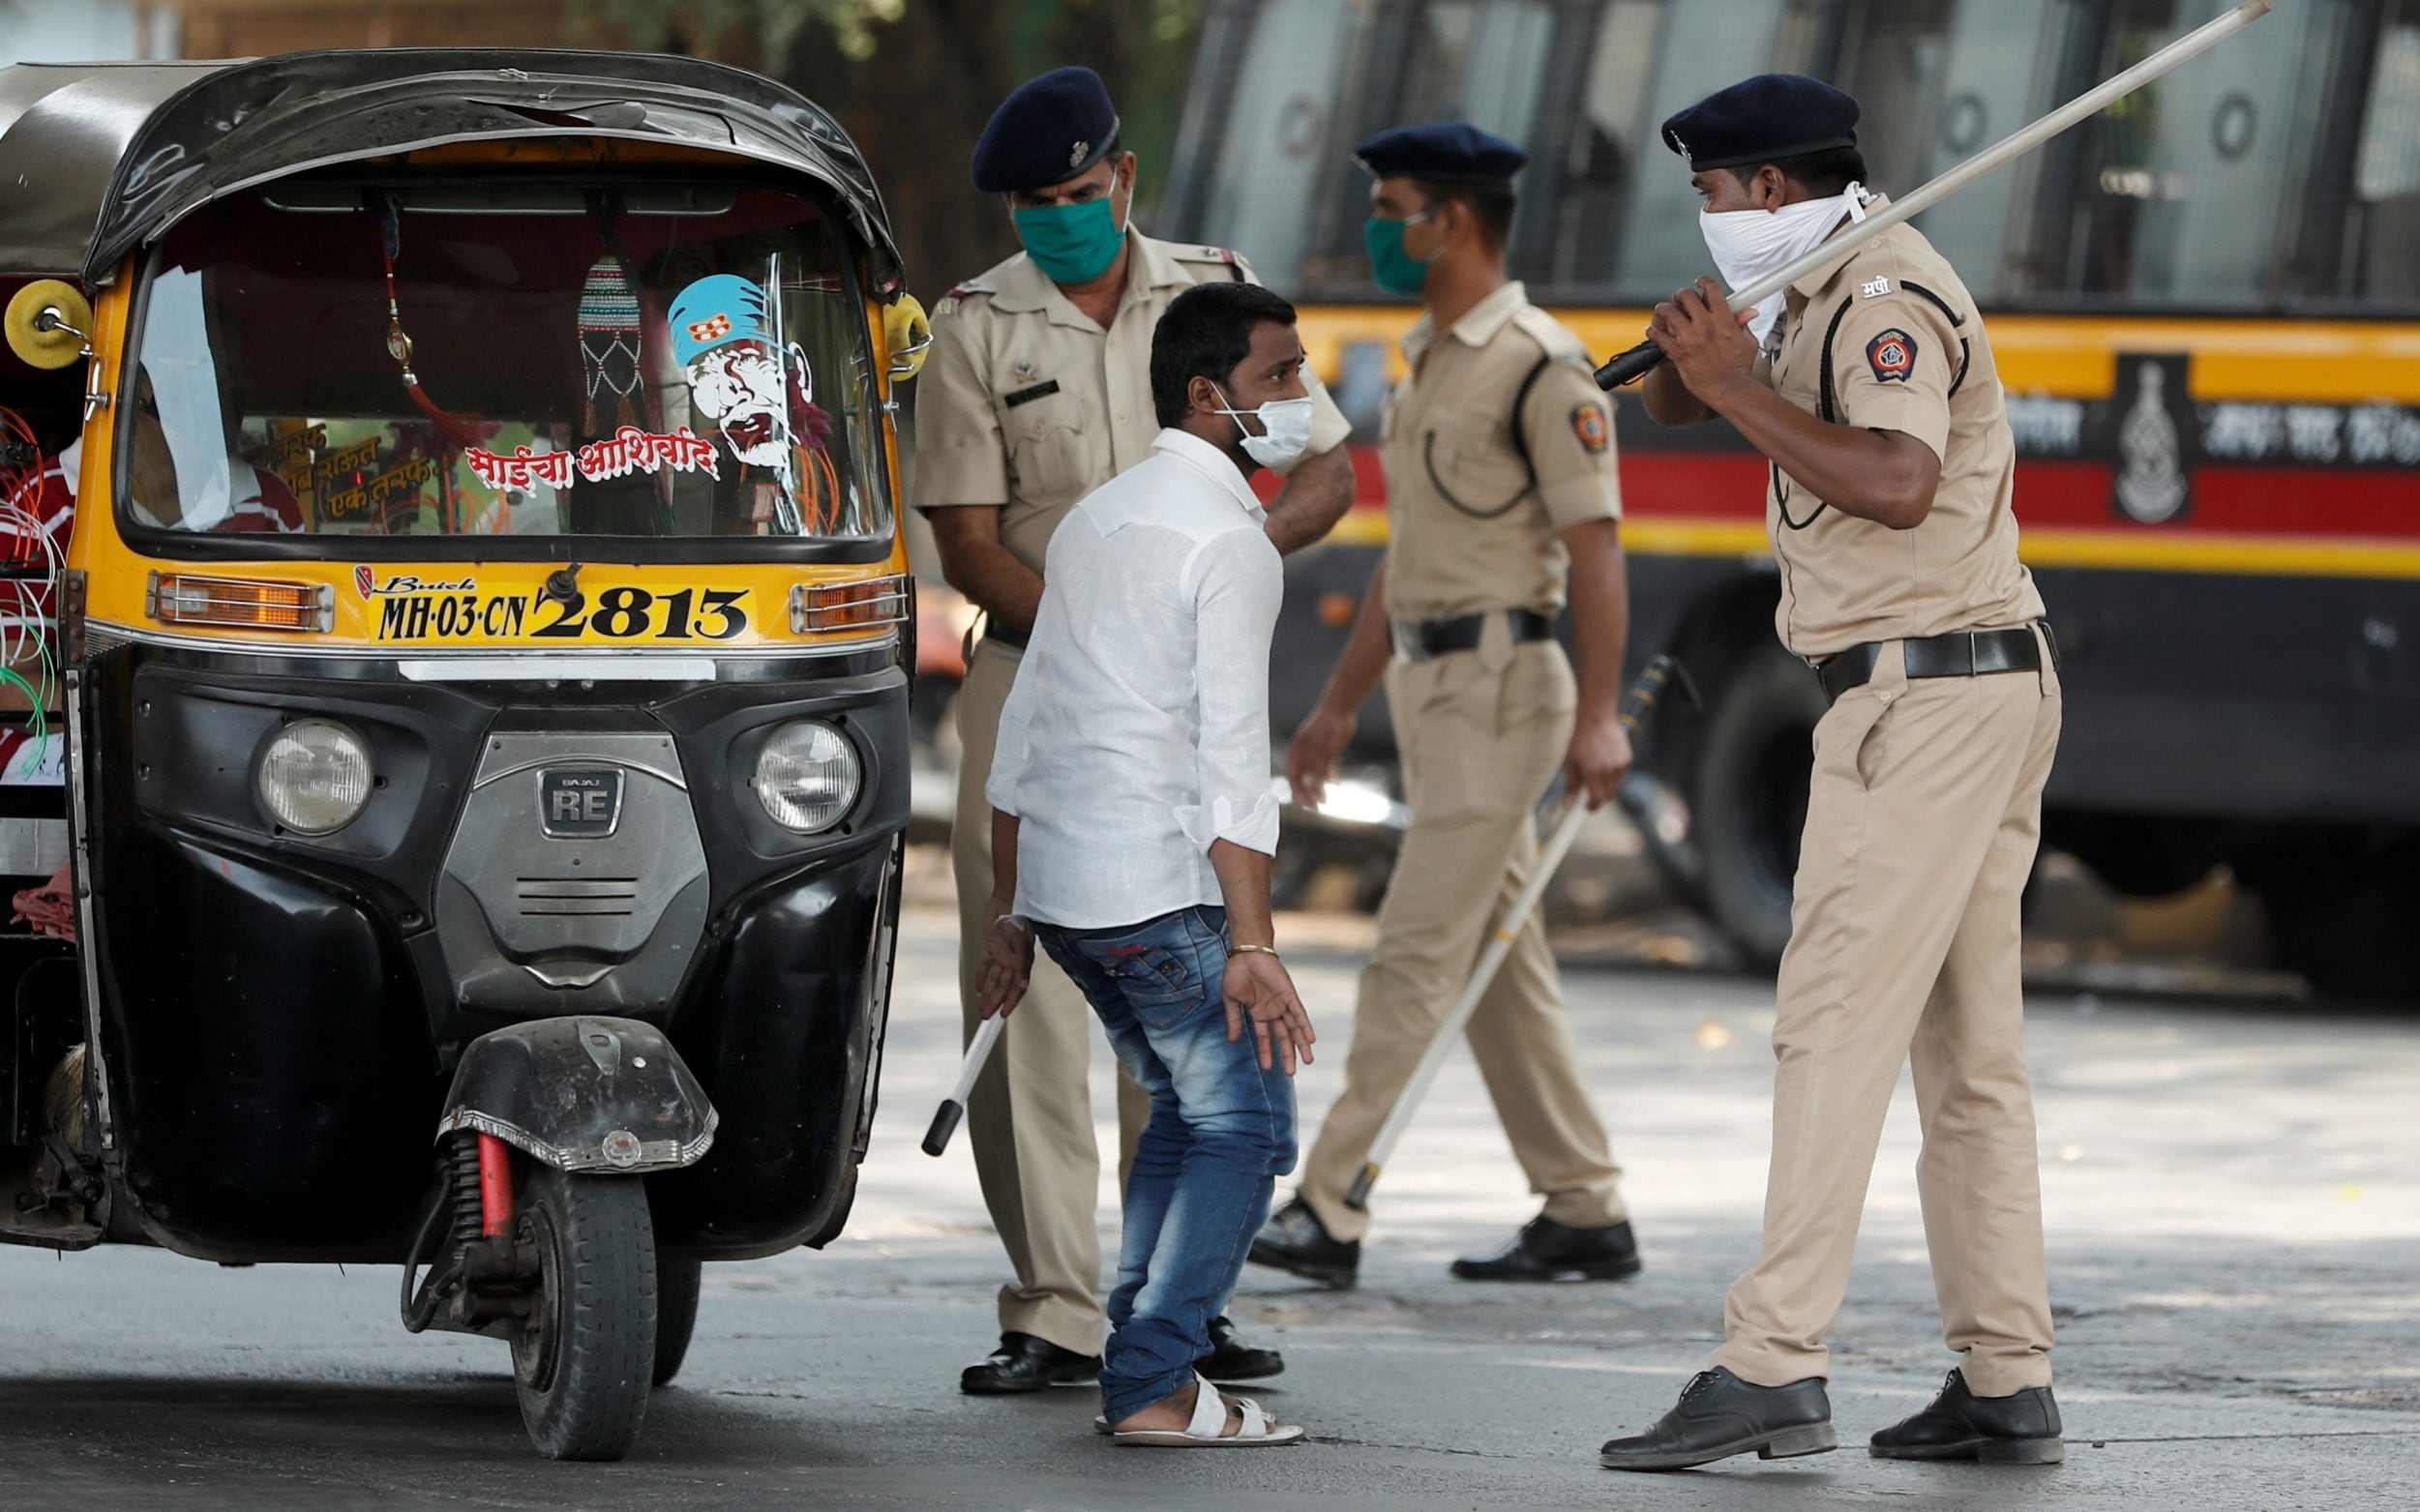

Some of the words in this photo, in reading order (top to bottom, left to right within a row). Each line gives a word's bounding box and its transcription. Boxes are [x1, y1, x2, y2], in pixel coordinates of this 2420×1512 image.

[465, 445, 573, 496] साईंचा
[578, 426, 720, 482] आशिर्वाद
[373, 577, 475, 594] Buick
[529, 587, 749, 640] 2813
[553, 789, 608, 821] RE
